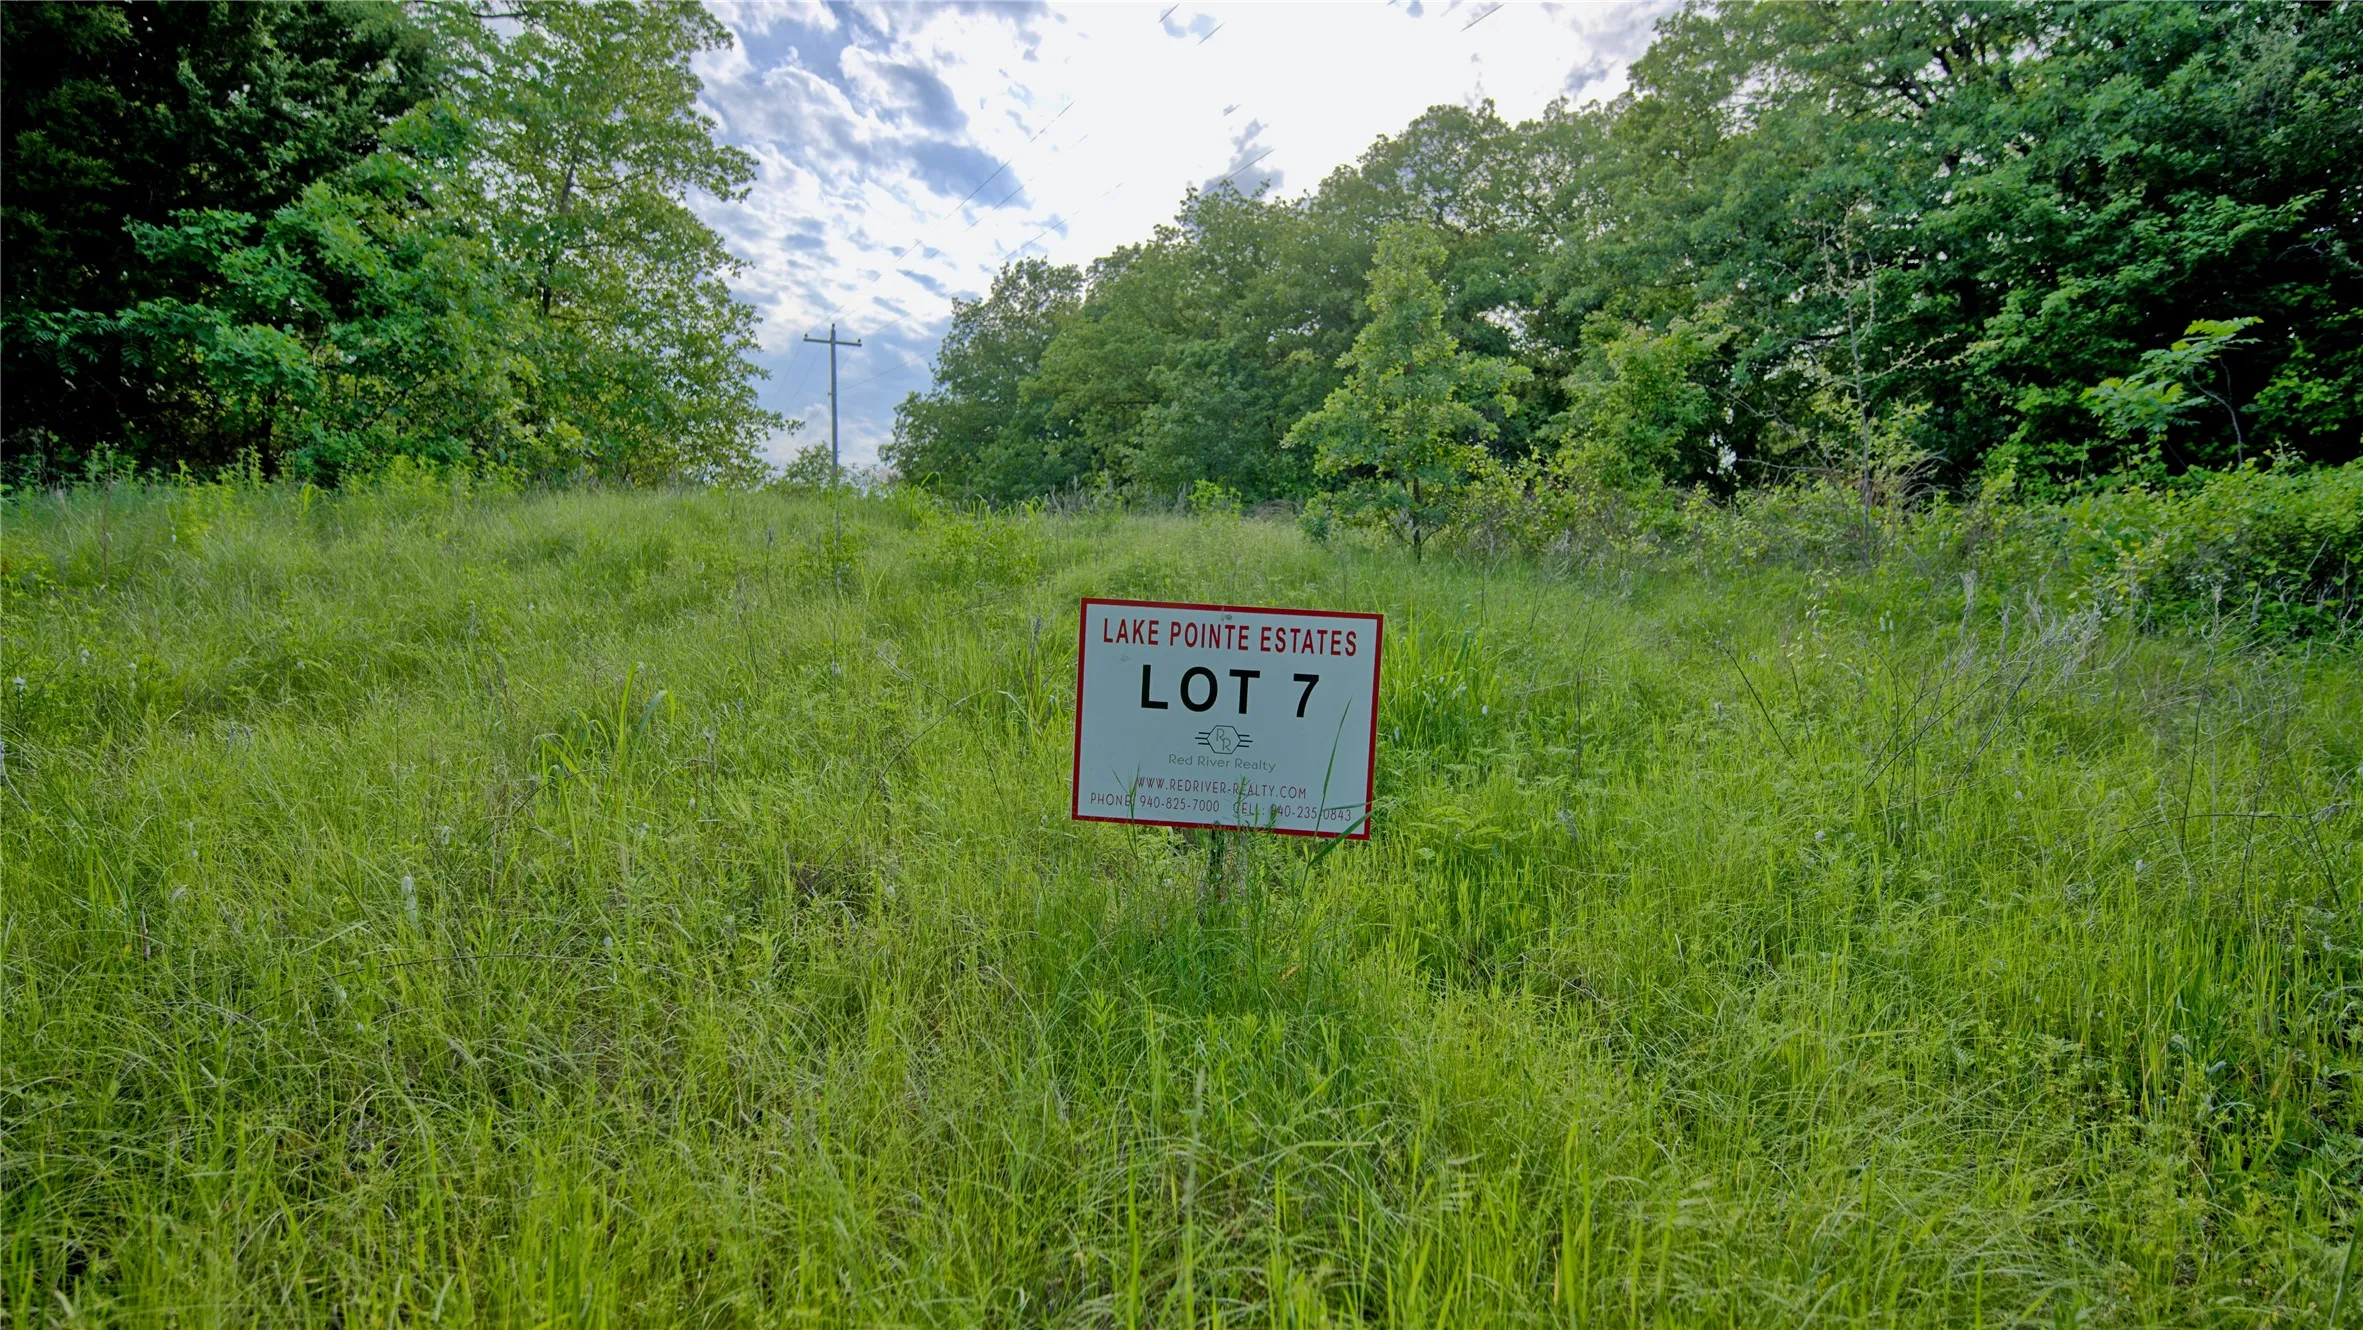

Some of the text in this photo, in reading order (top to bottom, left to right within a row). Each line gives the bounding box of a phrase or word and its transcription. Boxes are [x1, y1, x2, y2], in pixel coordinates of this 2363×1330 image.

[1103, 618, 1357, 656] LAKE POINTE ESTATES
[1140, 664, 1319, 718] LOT 7
[1168, 754, 1276, 773] Red River Realty
[1091, 792, 1352, 821] PHONE 940-825-7000 CEL: 940-2350843
